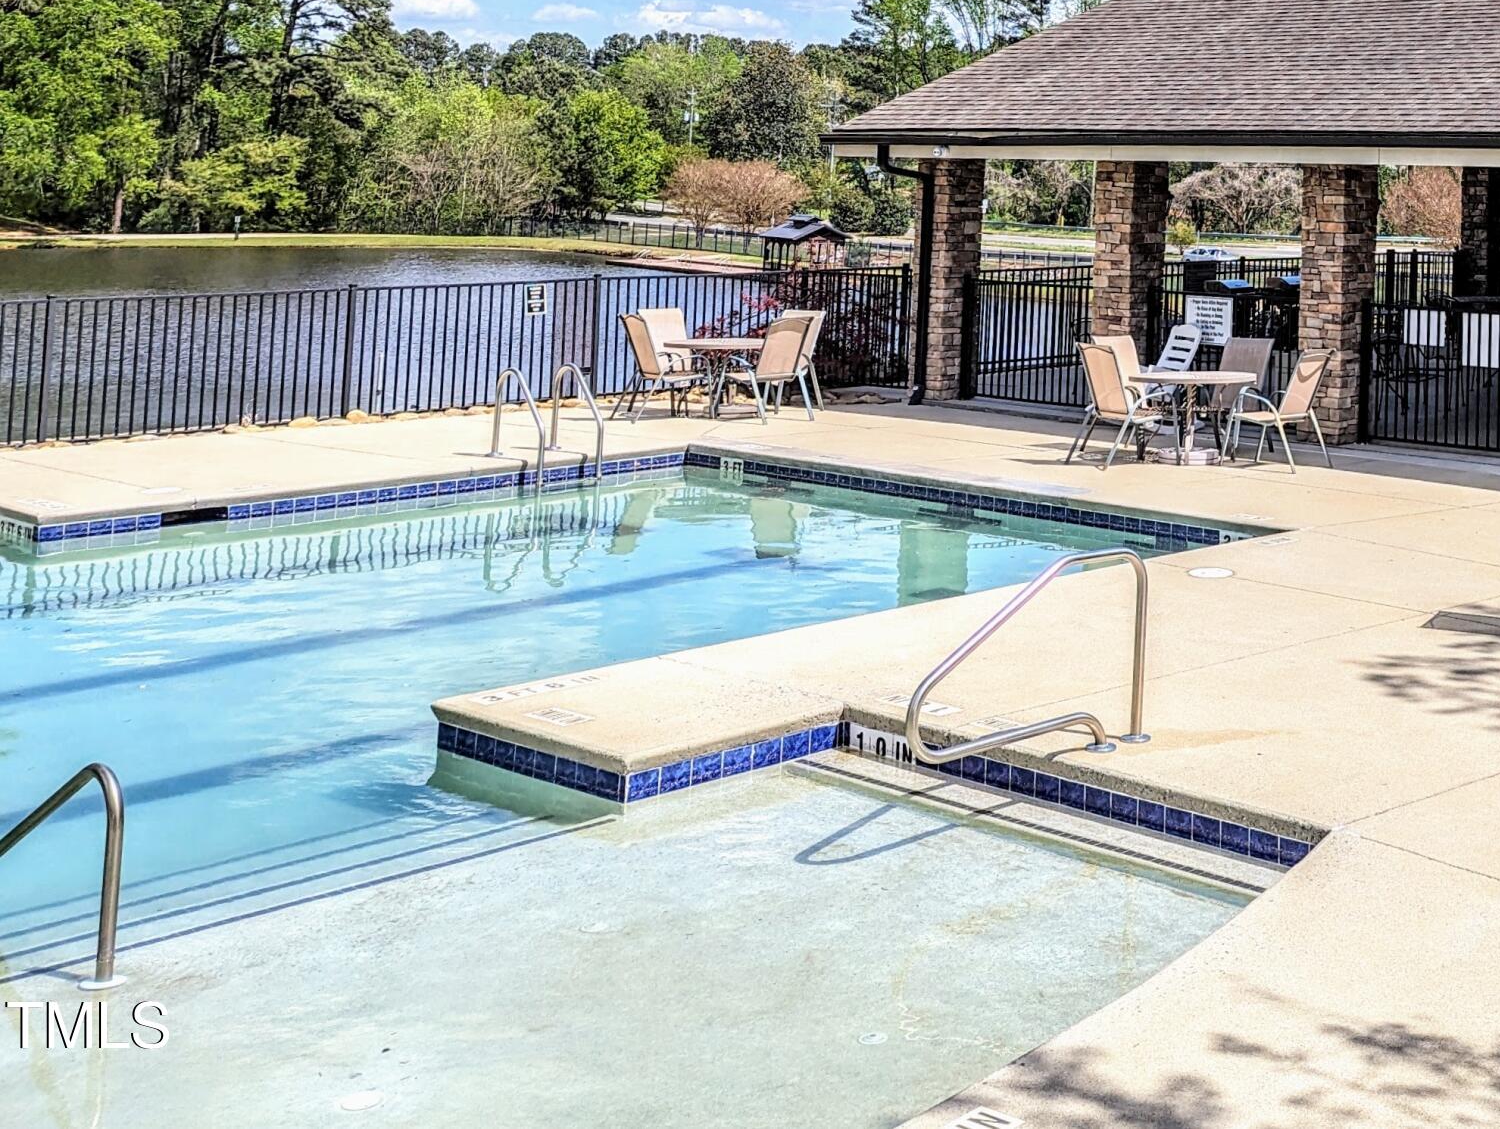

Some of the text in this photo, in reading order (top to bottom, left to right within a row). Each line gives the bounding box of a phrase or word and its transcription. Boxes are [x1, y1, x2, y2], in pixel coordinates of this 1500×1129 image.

[507, 687, 537, 697] FT
[571, 675, 601, 684] IN
[896, 740, 913, 764] IN
